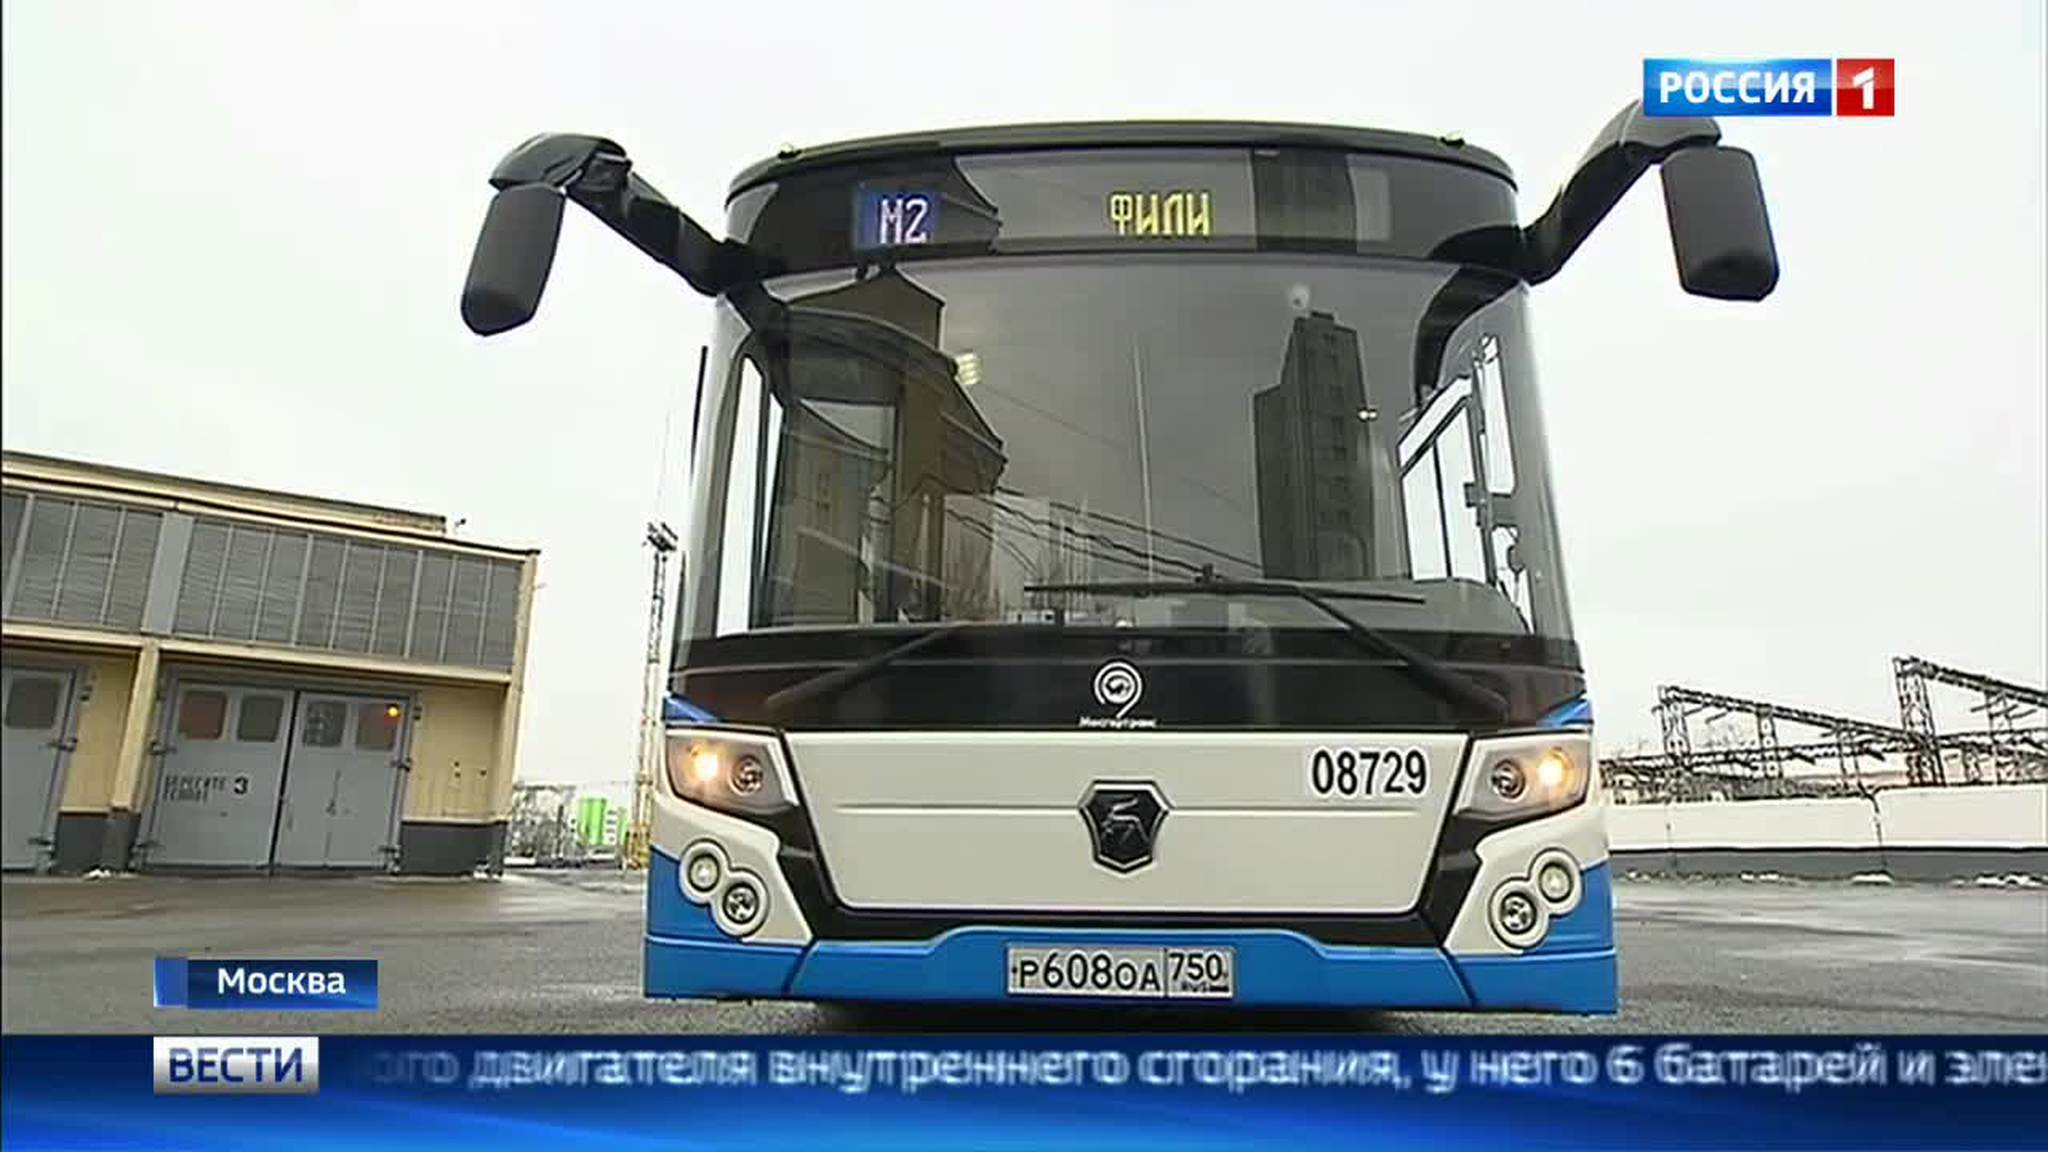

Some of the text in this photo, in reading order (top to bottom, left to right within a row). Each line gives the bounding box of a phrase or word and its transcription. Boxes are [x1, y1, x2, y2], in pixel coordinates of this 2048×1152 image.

[879, 196, 929, 245] М2
[1109, 191, 1212, 236] ФИЛИ
[233, 776, 248, 795] 3
[1311, 749, 1428, 796] 08729
[1169, 952, 1223, 982] 750
